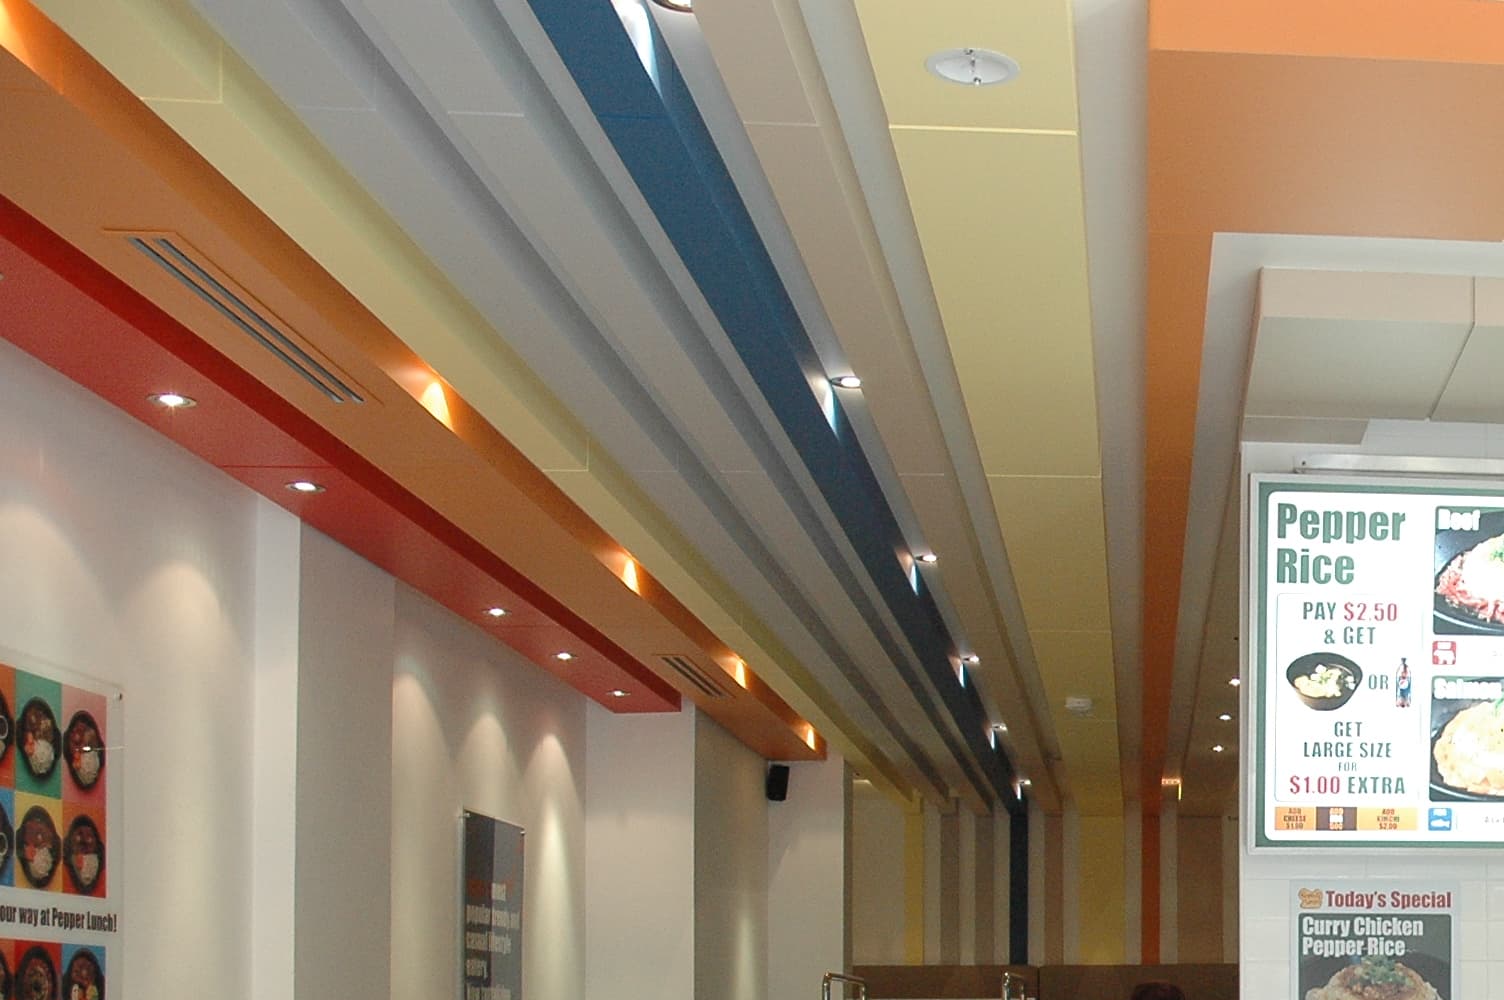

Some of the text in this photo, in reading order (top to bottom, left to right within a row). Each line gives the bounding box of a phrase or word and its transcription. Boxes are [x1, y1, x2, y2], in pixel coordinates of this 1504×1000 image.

[1277, 503, 1406, 544] Pepper
[1276, 548, 1355, 584] Rice
[1303, 601, 1398, 621] PAY $2.50
[1324, 626, 1376, 645] & GET
[1368, 674, 1389, 690] OR
[1334, 721, 1363, 738] GET
[1303, 741, 1392, 758] LARGE SIZE
[1338, 761, 1358, 772] FOR
[1289, 775, 1406, 795] $1.00 EXTRA
[1326, 891, 1387, 909] Today's
[1391, 891, 1452, 909] Special
[19, 907, 39, 927] way
[40, 908, 51, 926] at
[52, 907, 85, 930] Pepper
[87, 911, 117, 933] Lunch!
[1302, 916, 1424, 937] Curry Chicken
[1302, 937, 1406, 957] Pepper Rice
